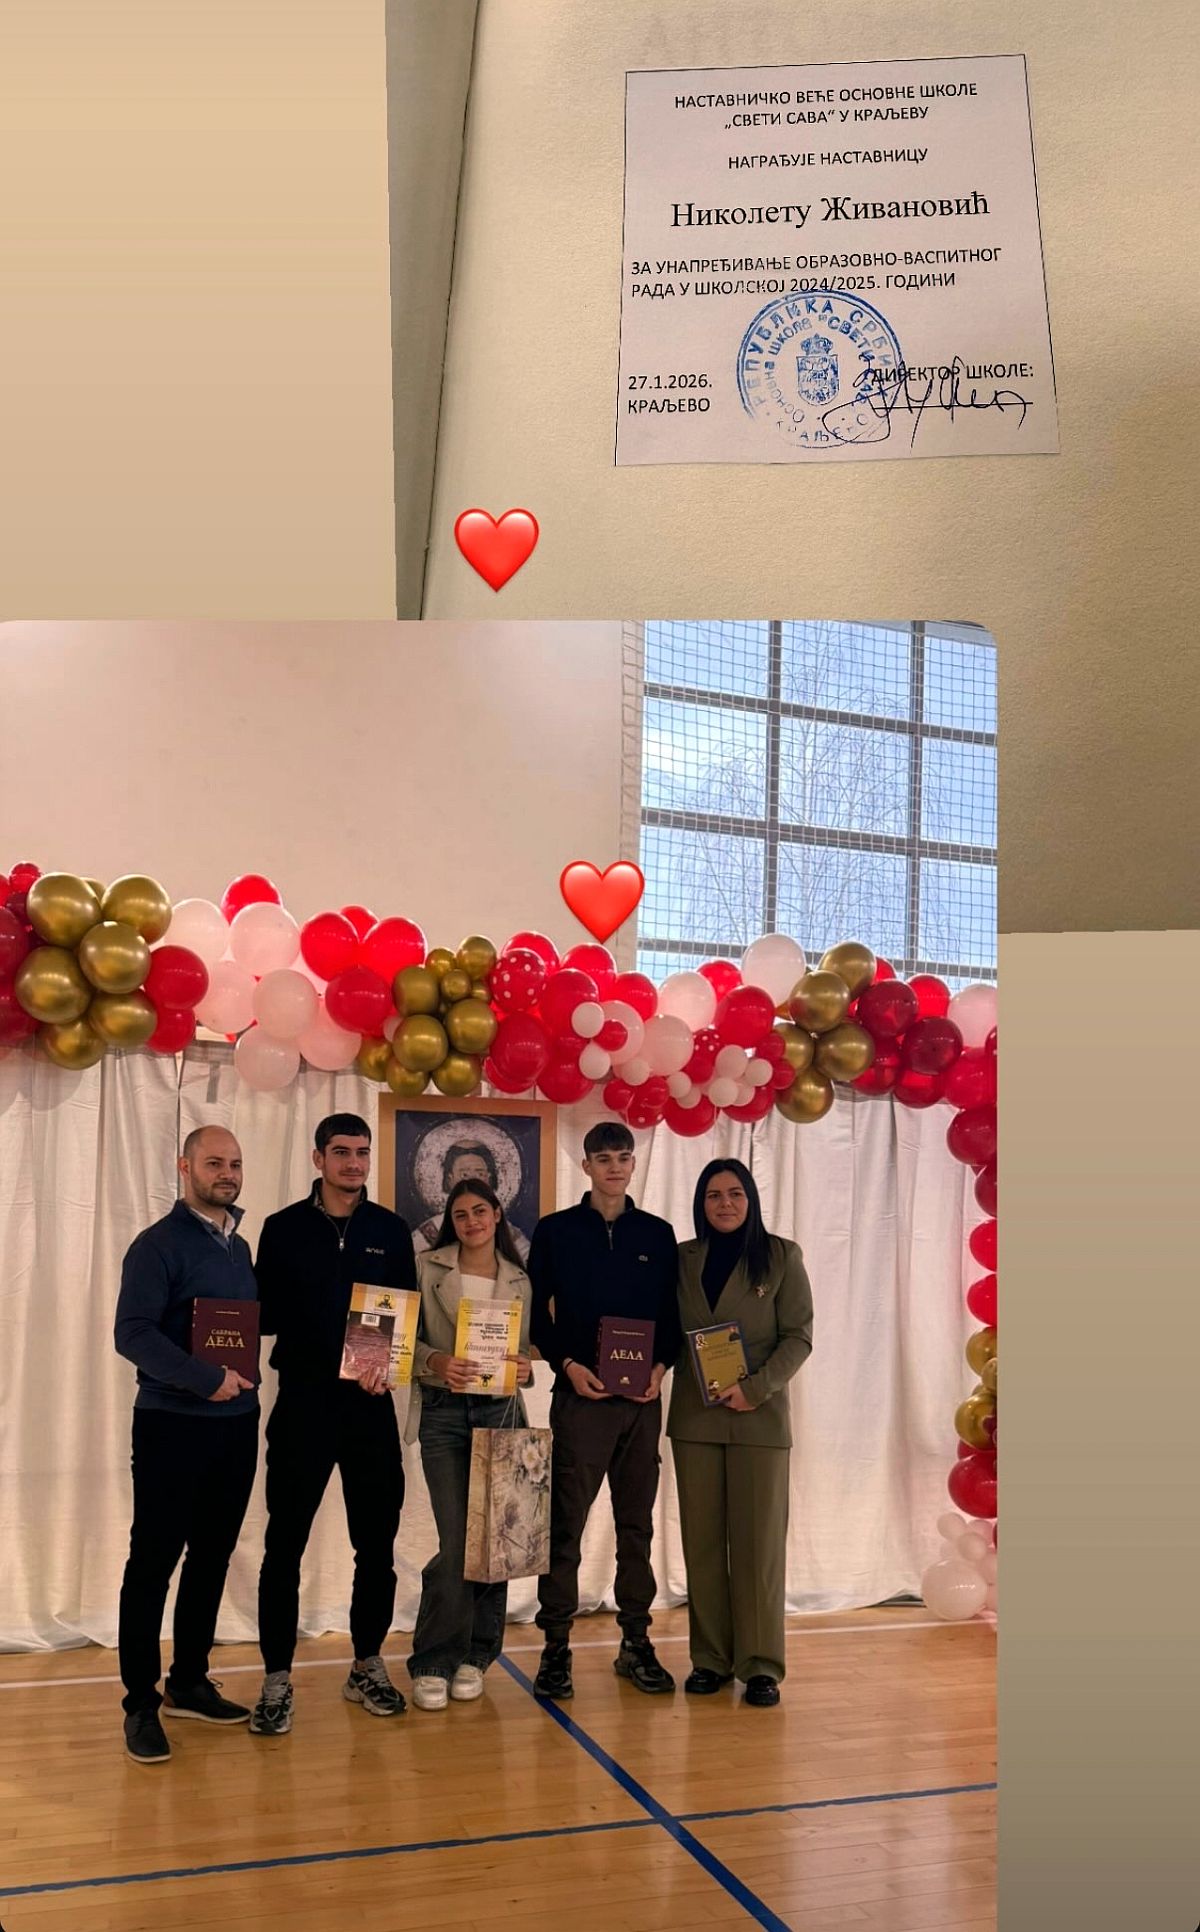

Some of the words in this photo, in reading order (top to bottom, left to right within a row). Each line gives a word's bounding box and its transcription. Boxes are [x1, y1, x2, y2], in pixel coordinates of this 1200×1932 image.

[675, 91, 790, 109] НАСТАВНИЧКО
[796, 89, 834, 103] ВЕЋЕ
[840, 86, 915, 102] ОСНОВНЕ
[920, 83, 977, 98] ШКОЛЕ
[725, 112, 782, 129] „СВЕТИ
[839, 110, 849, 123] У
[854, 107, 929, 122] КРАЉЕВУ
[729, 153, 815, 169] НАГРАЂУЈЕ
[820, 148, 928, 166] НАСТАВНИЦУ
[670, 202, 811, 228] Николету
[820, 191, 991, 221] Живановић
[631, 262, 651, 275] ЗА
[656, 256, 791, 274] УНАПРЕЂИВАЊЕ
[796, 248, 1001, 269] ОБРАЗОВНО-ВАСПИТНОГ
[631, 283, 675, 300] РАДА
[679, 282, 690, 296] У
[695, 280, 785, 297] ШКОЛСКОЈ
[790, 276, 881, 293] 2024/2025.
[886, 273, 955, 290] ГОДИНИ
[629, 374, 712, 390] 27.1.2026.
[871, 365, 960, 385] ДИРЕКТОР
[966, 363, 1034, 380] ШКОЛЕ:
[628, 398, 710, 414] КРАЉЕВО
[205, 1335, 245, 1348] ДЕЛА
[610, 1348, 644, 1361] ДЕЛА
